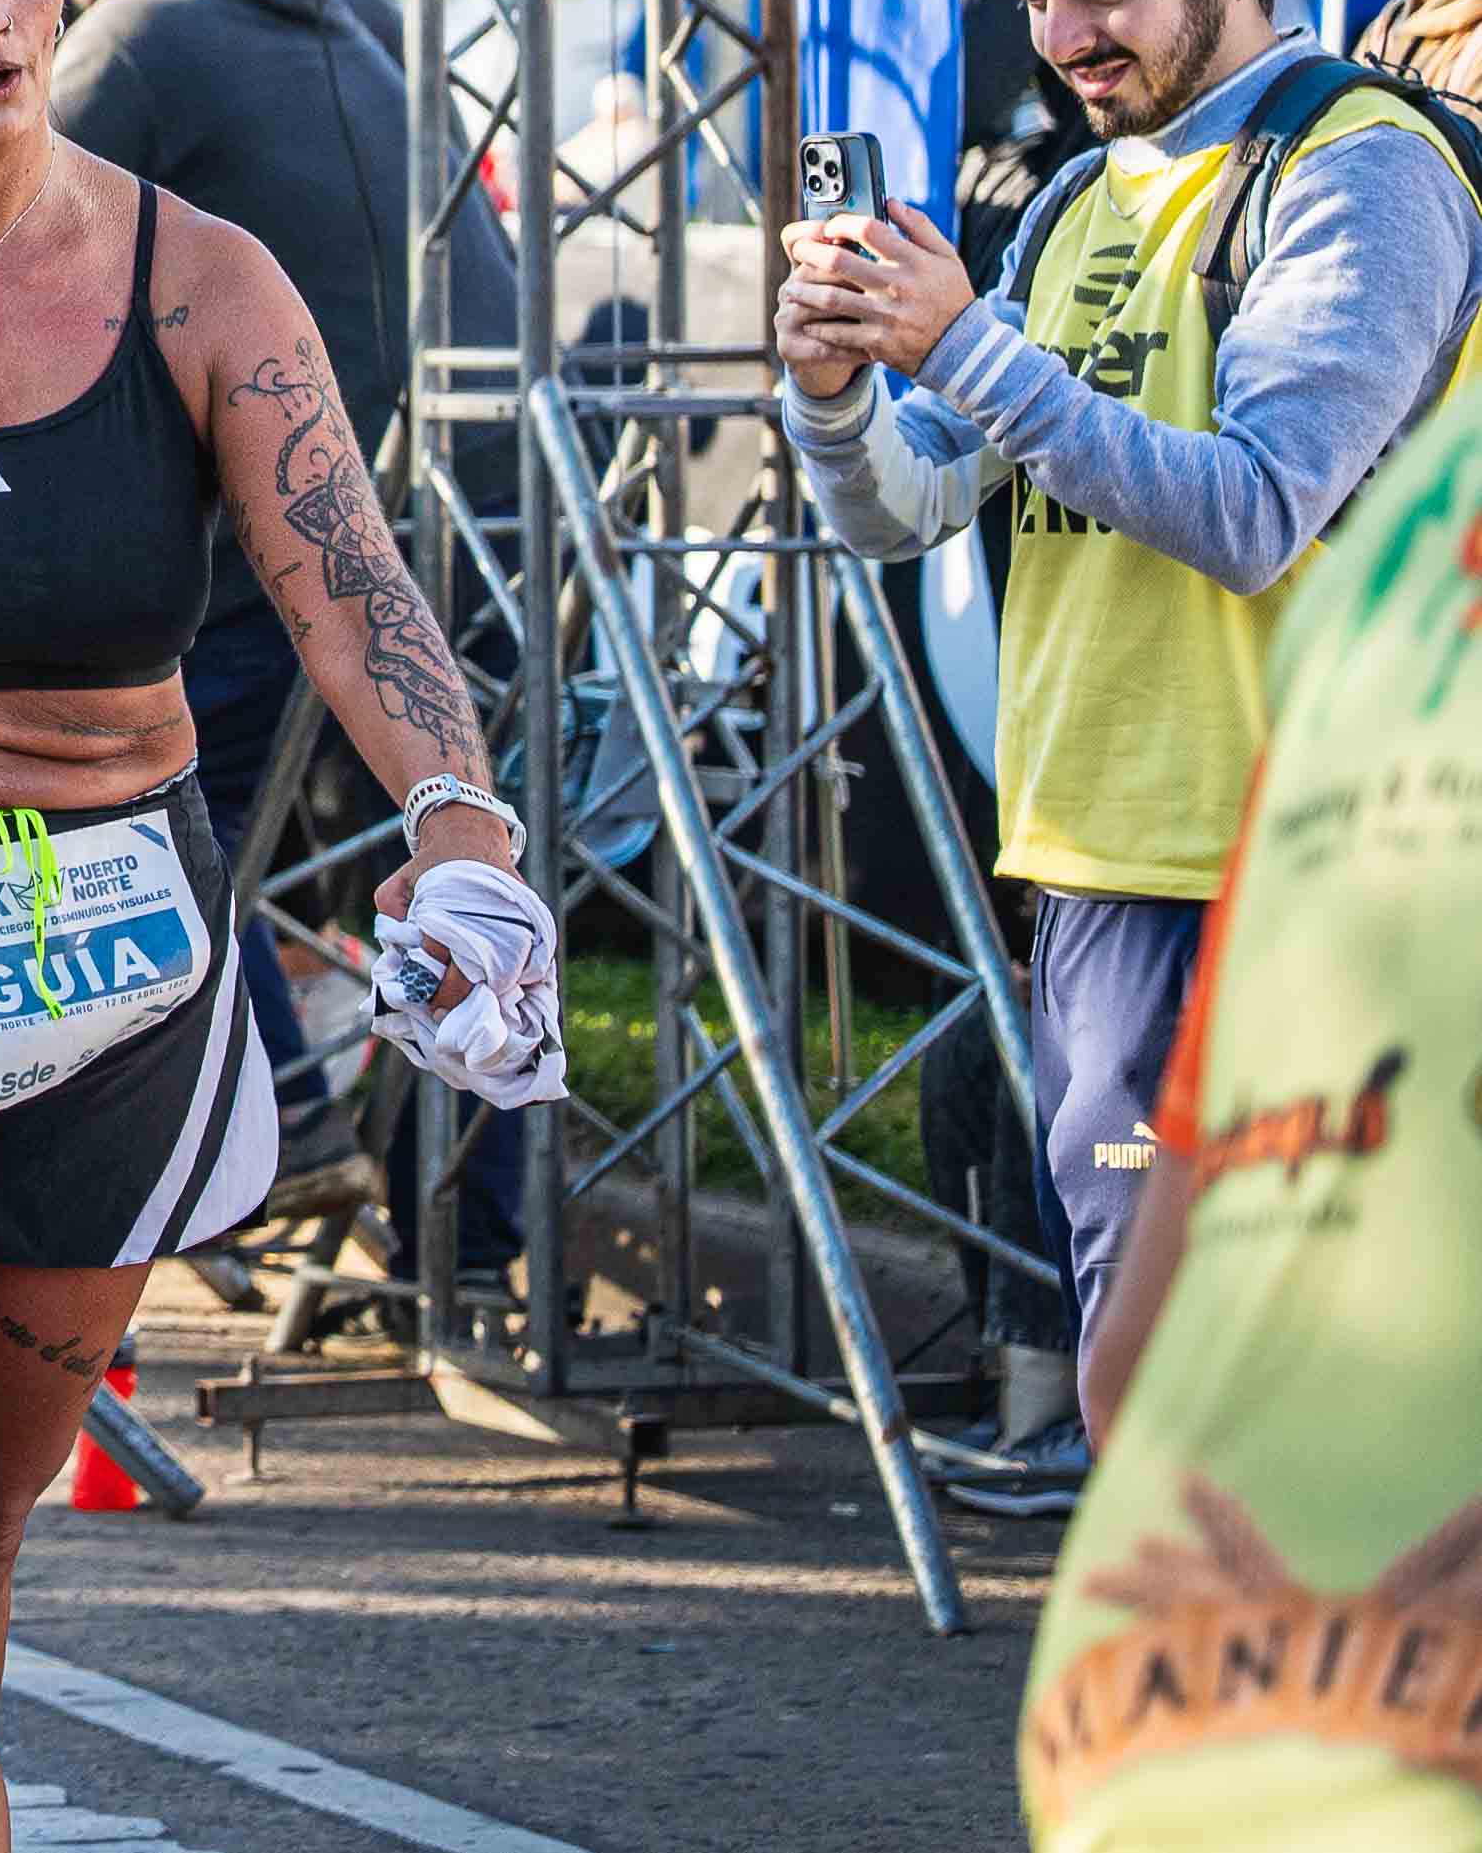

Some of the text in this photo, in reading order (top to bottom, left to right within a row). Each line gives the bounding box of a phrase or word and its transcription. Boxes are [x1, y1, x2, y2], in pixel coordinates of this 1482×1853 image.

[68, 854, 138, 883] PUERTO
[72, 874, 133, 902] NORTE
[118, 888, 172, 910] VISUALES
[0, 1018, 36, 1033] NORTE
[120, 994, 133, 1006] DE
